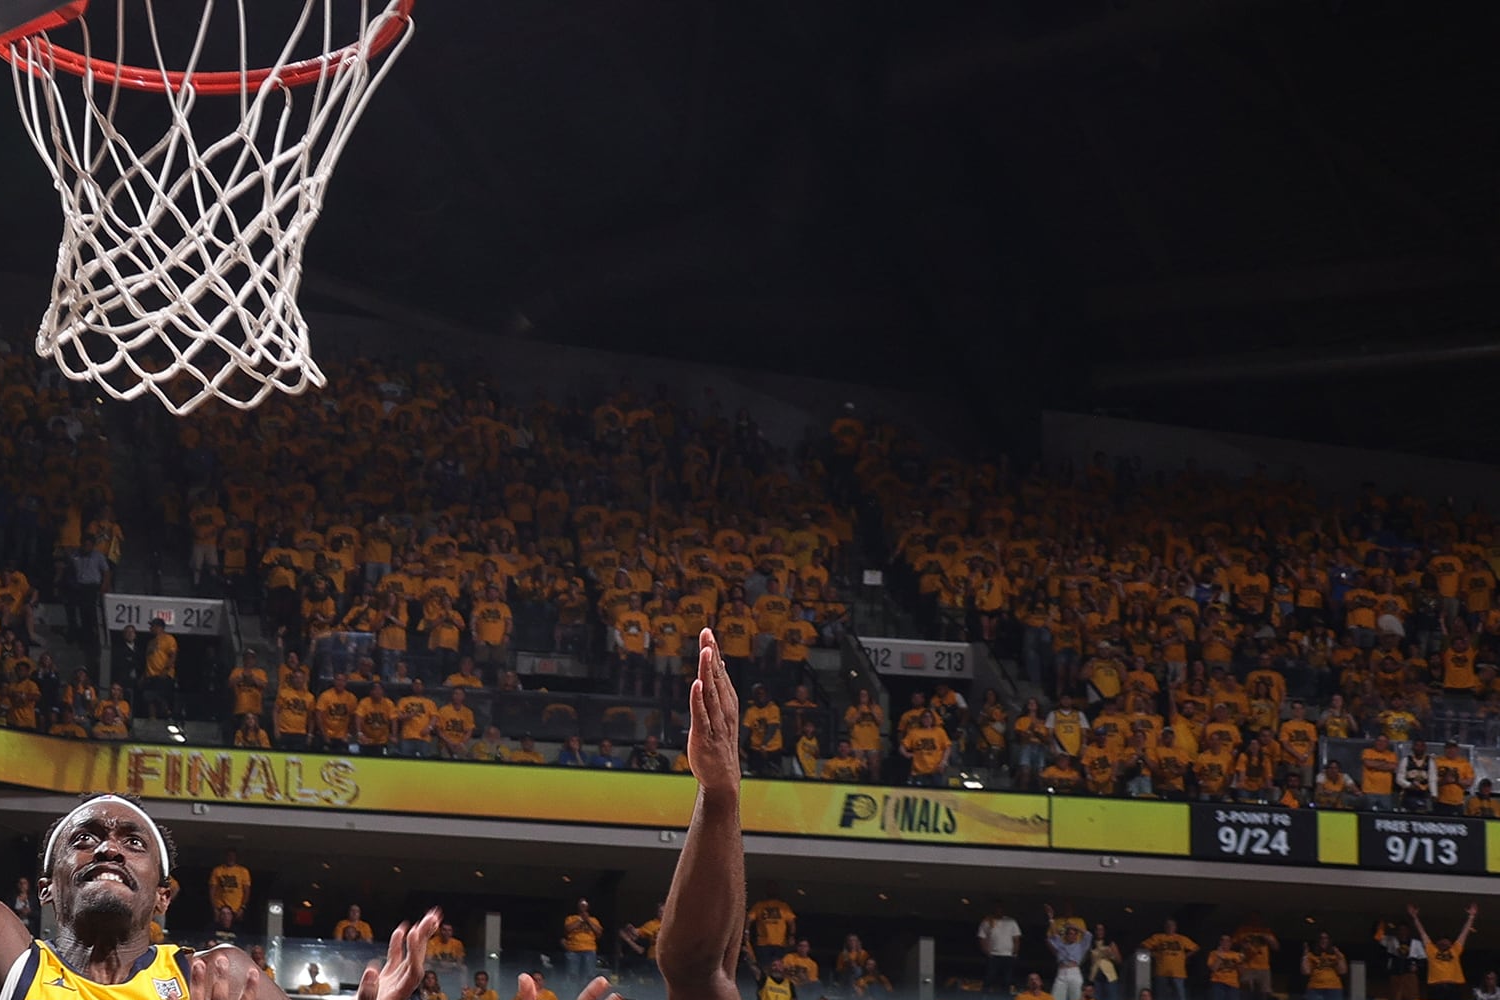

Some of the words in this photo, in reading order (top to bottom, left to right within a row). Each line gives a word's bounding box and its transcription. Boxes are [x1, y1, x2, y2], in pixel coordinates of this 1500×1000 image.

[114, 602, 142, 625] 211
[182, 608, 215, 629] 212
[934, 648, 965, 673] 213
[125, 745, 362, 807] FINALS
[1214, 810, 1271, 826] 3-POINT
[1374, 818, 1410, 834] FREE
[1411, 820, 1469, 837] THROWS
[1216, 826, 1291, 857] 9/24
[1385, 834, 1460, 866] 9/13
